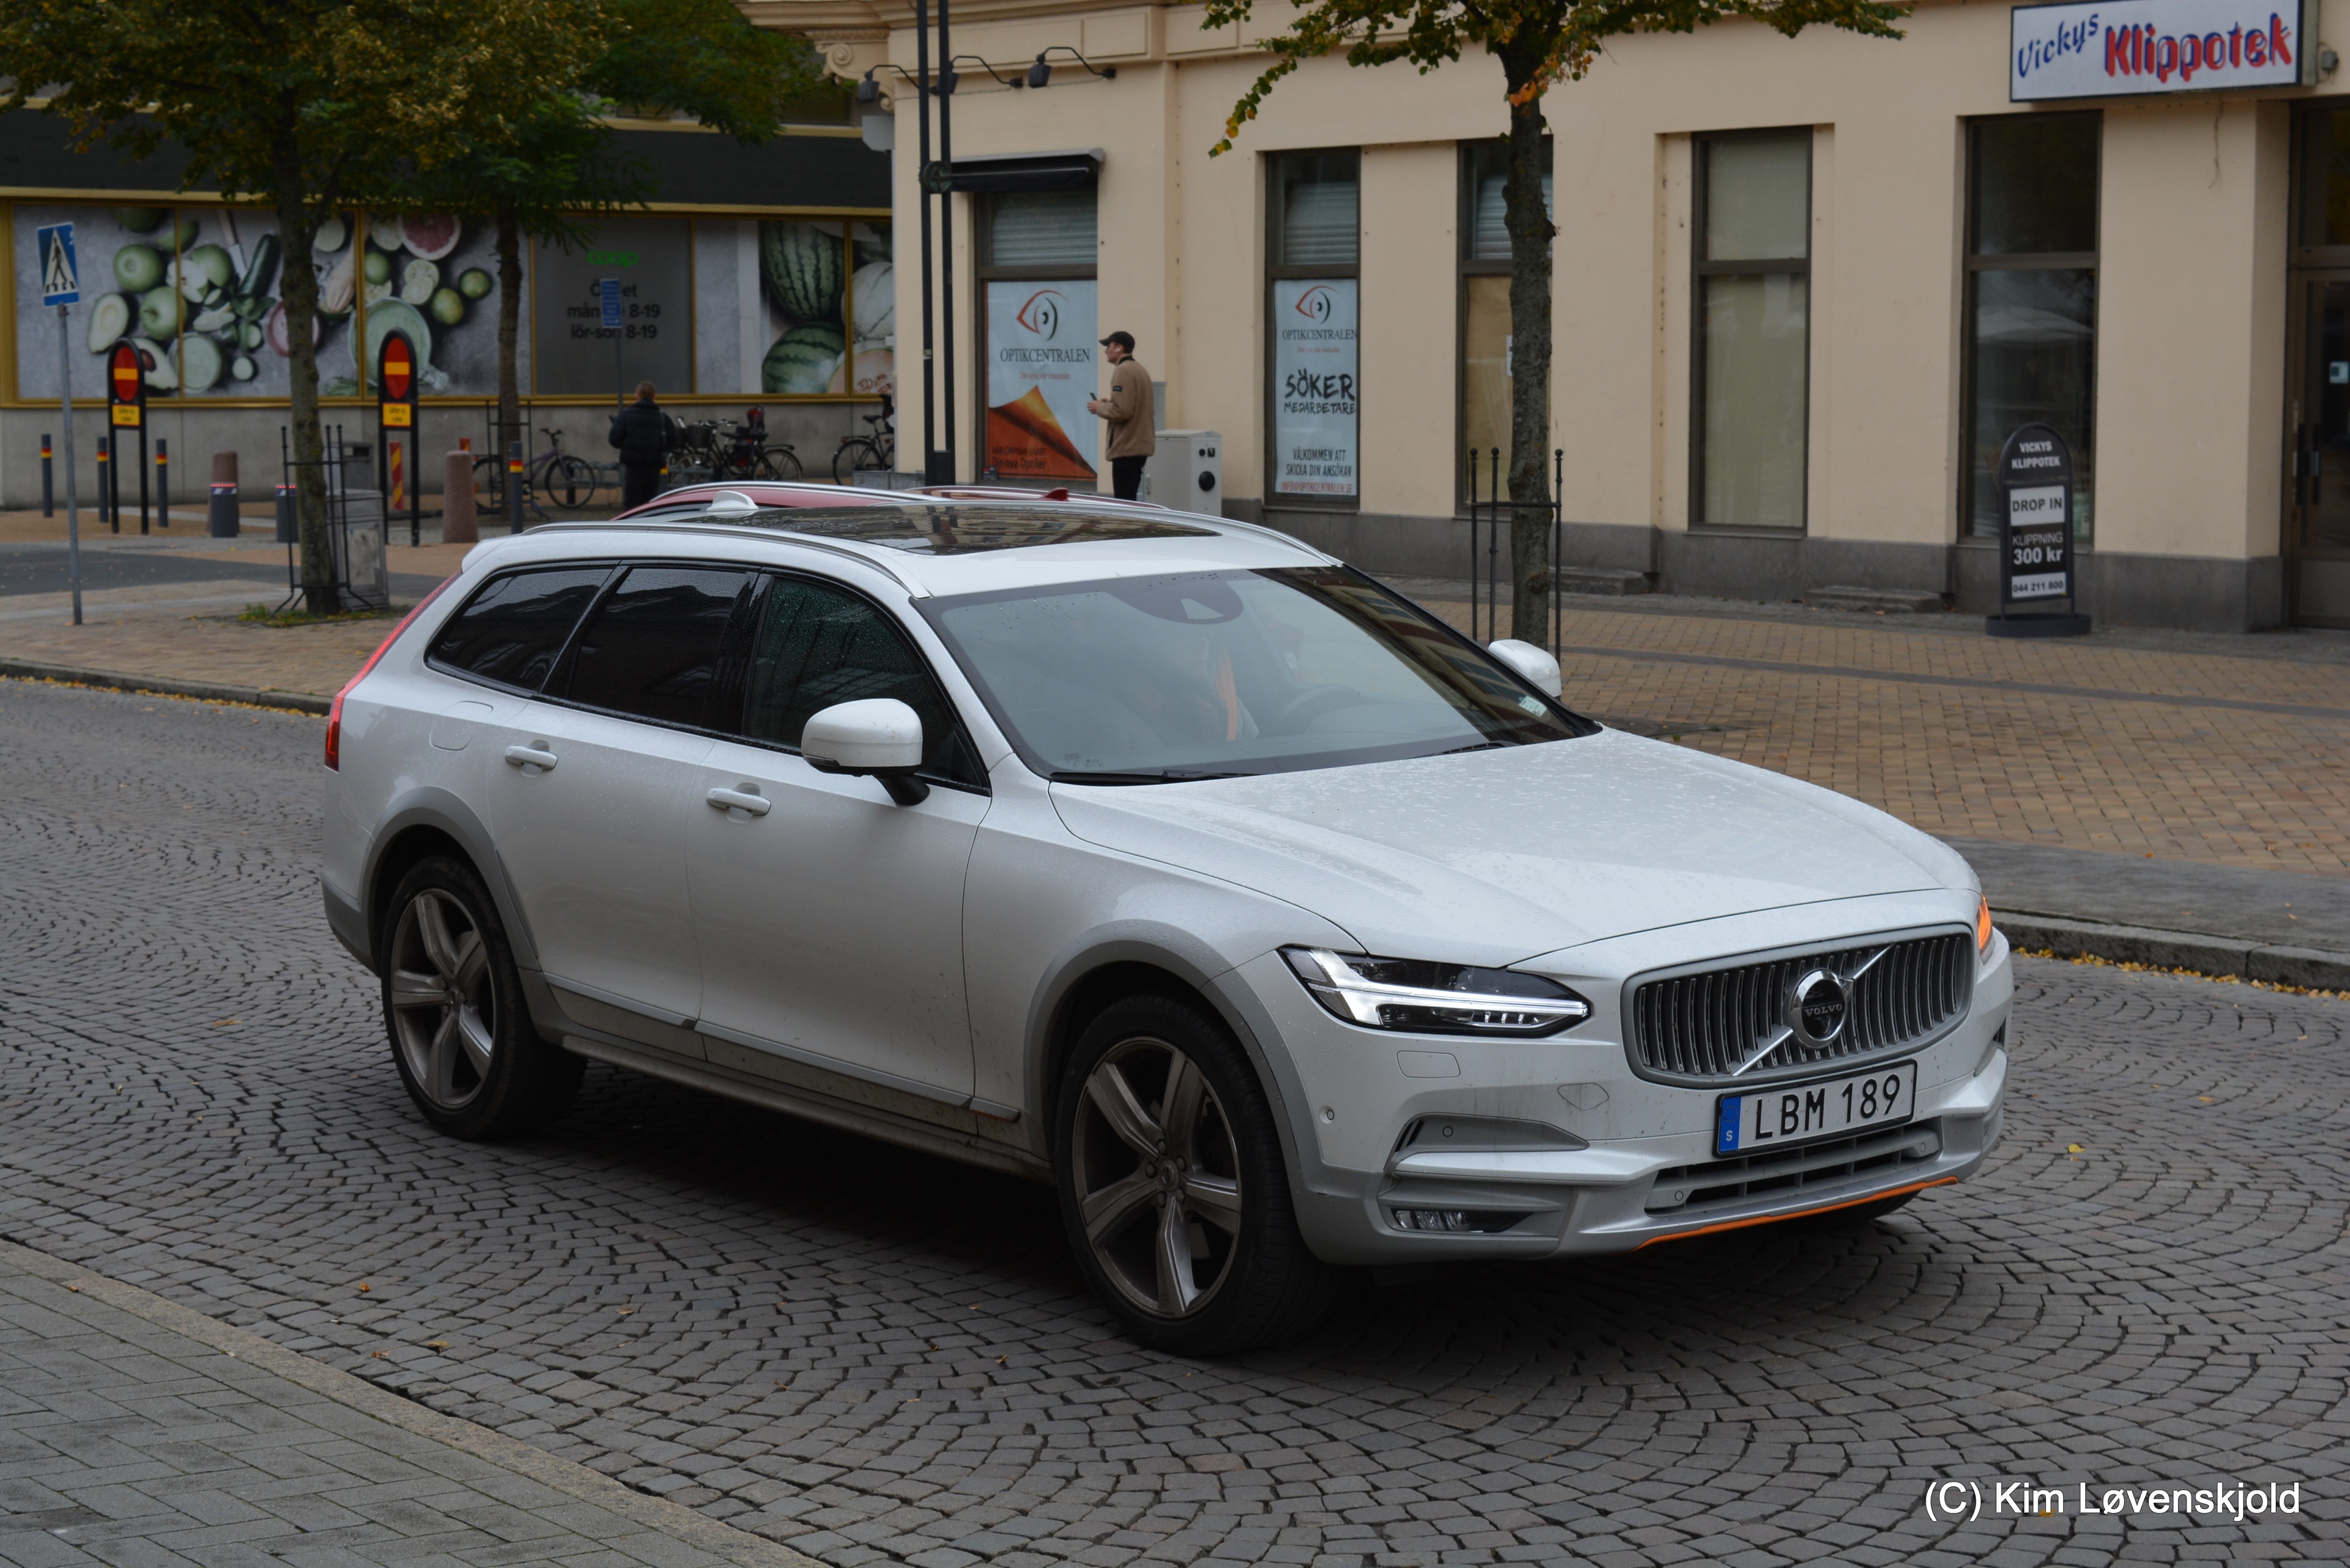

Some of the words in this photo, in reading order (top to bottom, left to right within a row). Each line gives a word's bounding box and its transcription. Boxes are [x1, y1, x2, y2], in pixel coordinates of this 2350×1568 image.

[2019, 13, 2099, 78] Vickys
[2105, 12, 2292, 84] Klippotek
[586, 250, 639, 268] coop
[590, 280, 638, 297] Öet
[629, 304, 660, 318] 8-19
[626, 324, 657, 338] 8-19
[1281, 329, 1356, 340] OPTIKCENTRALEN
[1000, 348, 1090, 363] OPTIKCENTRALEN
[1284, 368, 1355, 402] SÖKER
[1284, 402, 1356, 415] MEDARBETARE
[1292, 447, 1333, 461] VÄLKOMMEN
[1334, 450, 1346, 461] ATT
[2019, 441, 2053, 453] VICKYS
[992, 457, 1004, 467] Din
[1005, 460, 1018, 470] nya
[1019, 457, 1047, 471] Optiker
[2012, 455, 2061, 469] KLIPPOTEK
[1286, 463, 1307, 476] SKICKA
[1309, 465, 1321, 477] DIN
[1322, 463, 1352, 477] ANSÖKAN
[2012, 499, 2045, 512] DROP
[2050, 498, 2062, 510] IN
[2012, 531, 2064, 547] KLIPPNING
[2013, 547, 2043, 565] 300
[2046, 545, 2064, 562] kr
[2012, 583, 2029, 593] 044
[2031, 582, 2045, 591] 211
[1804, 1003, 1843, 1016] VOLVO
[1755, 1088, 1826, 1140] LBM
[1841, 1073, 1901, 1124] 189
[1725, 1130, 1733, 1141] S
